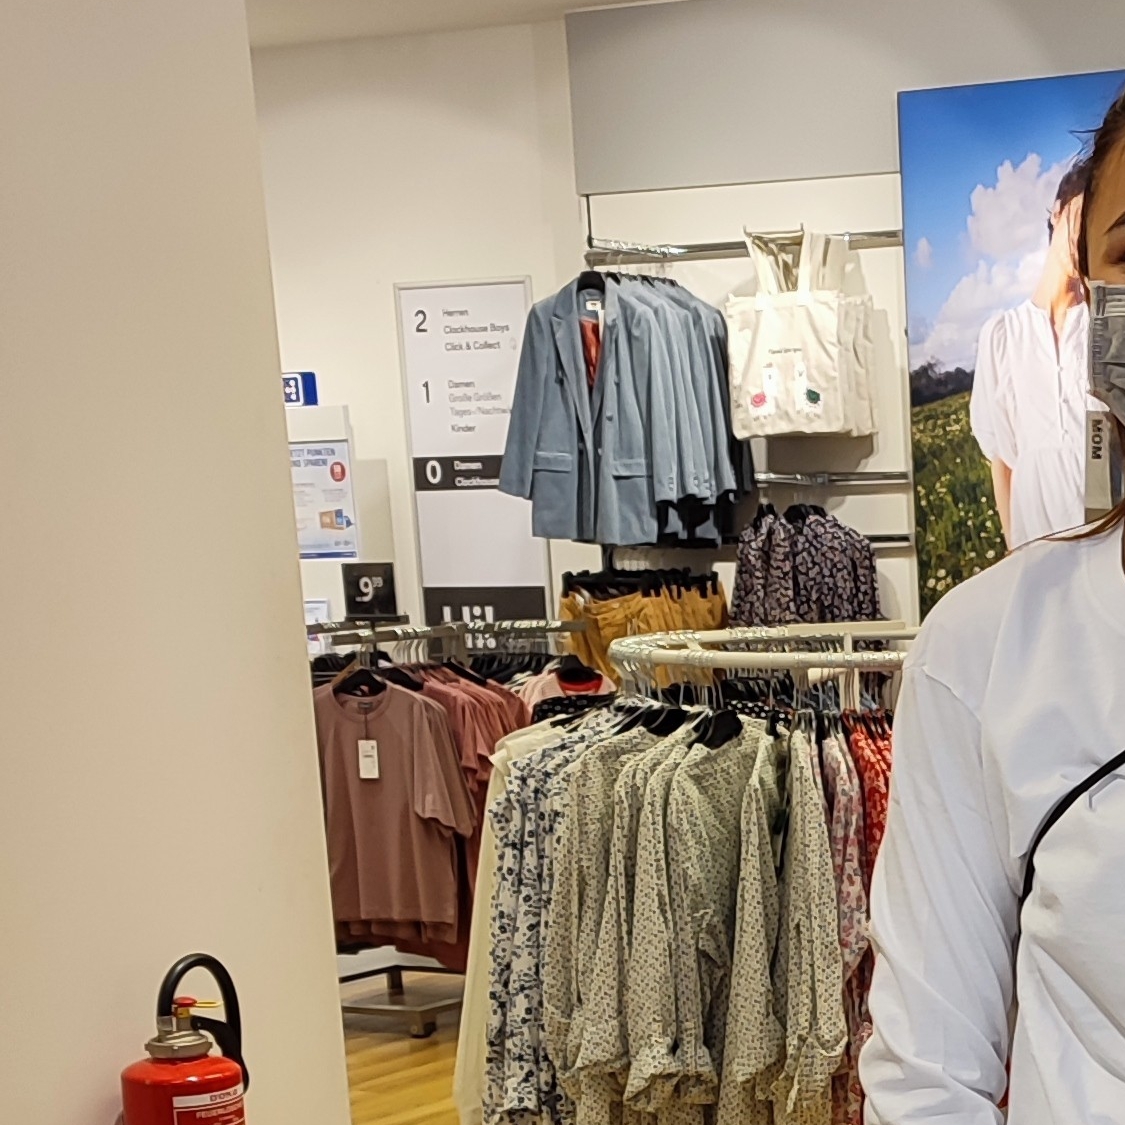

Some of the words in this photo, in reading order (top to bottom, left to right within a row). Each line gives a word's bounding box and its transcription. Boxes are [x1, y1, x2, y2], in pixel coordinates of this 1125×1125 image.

[414, 309, 428, 333] 2
[490, 322, 510, 333] Boys
[445, 342, 463, 352] Click
[465, 341, 471, 350] &
[473, 340, 501, 351] Collect
[422, 380, 431, 403] 1
[451, 423, 477, 432] Kinder
[425, 460, 442, 485] 0
[358, 576, 373, 602] 9
